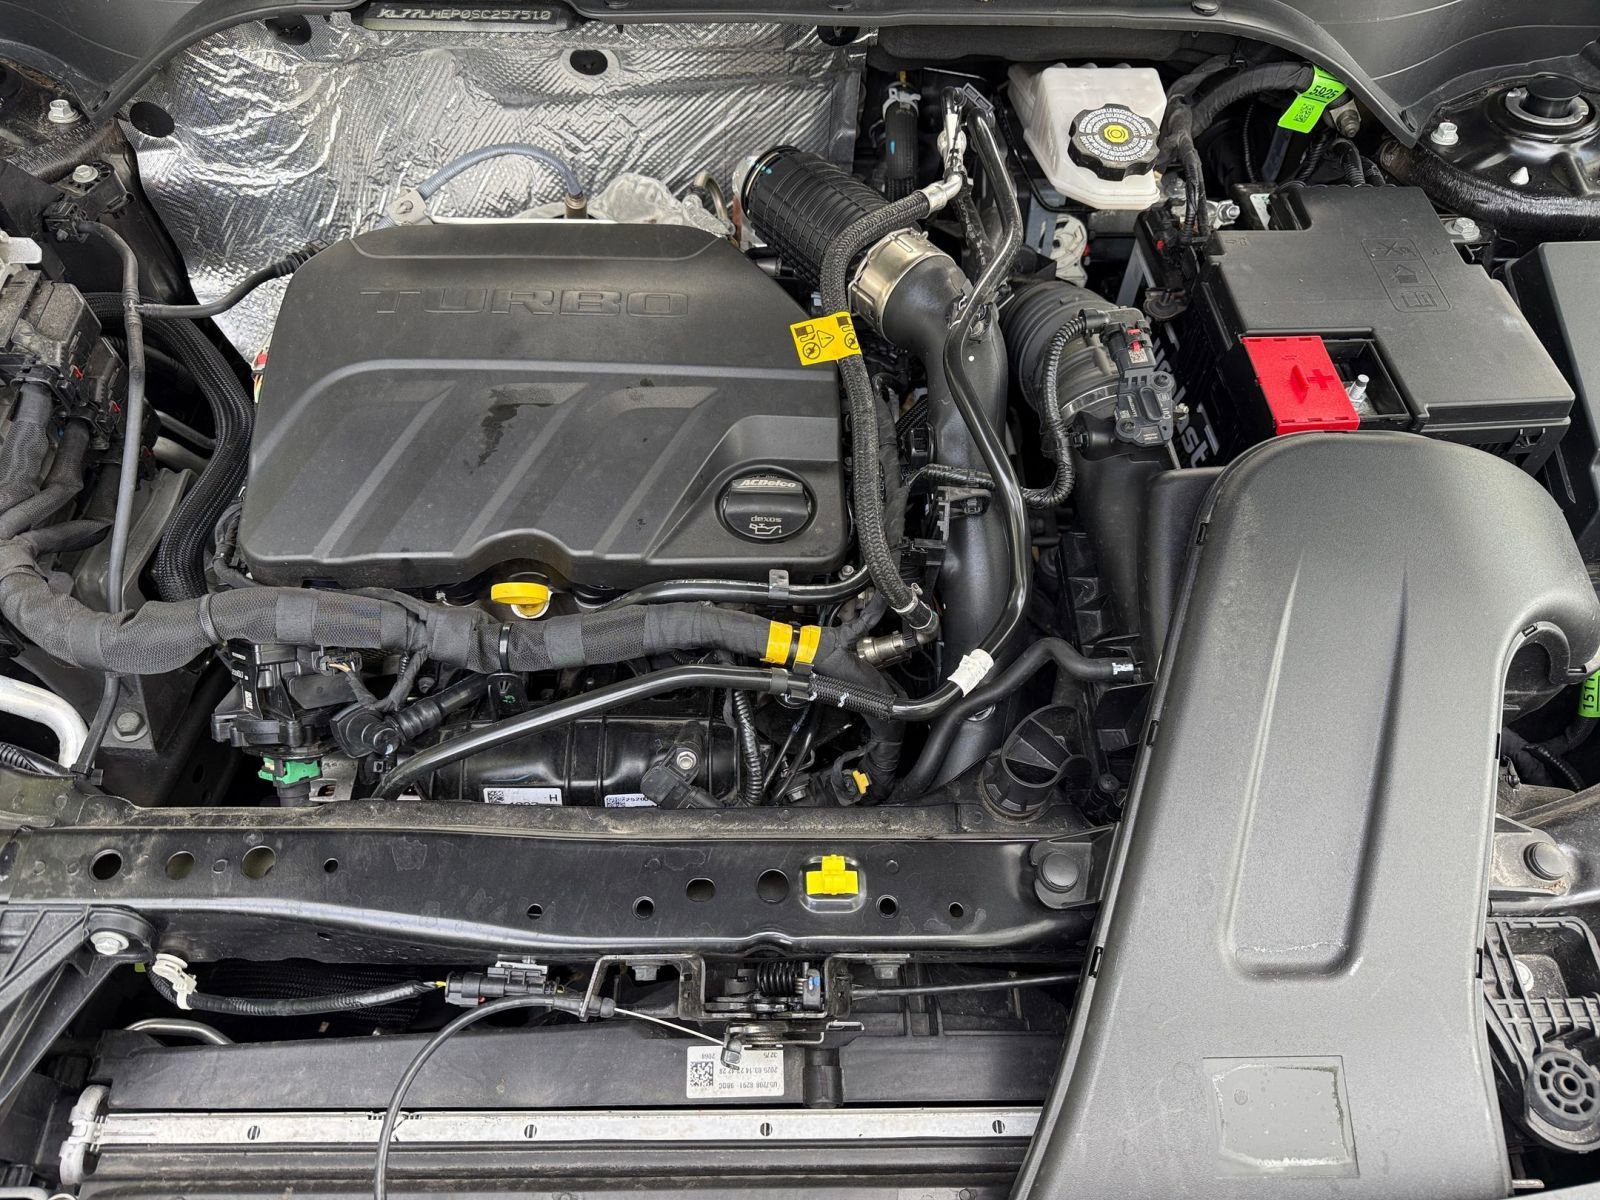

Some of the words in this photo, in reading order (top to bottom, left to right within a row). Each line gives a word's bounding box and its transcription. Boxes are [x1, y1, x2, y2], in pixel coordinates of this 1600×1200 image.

[359, 287, 689, 317] TURBO
[740, 479, 796, 488] ACDelco
[750, 515, 782, 523] dexos
